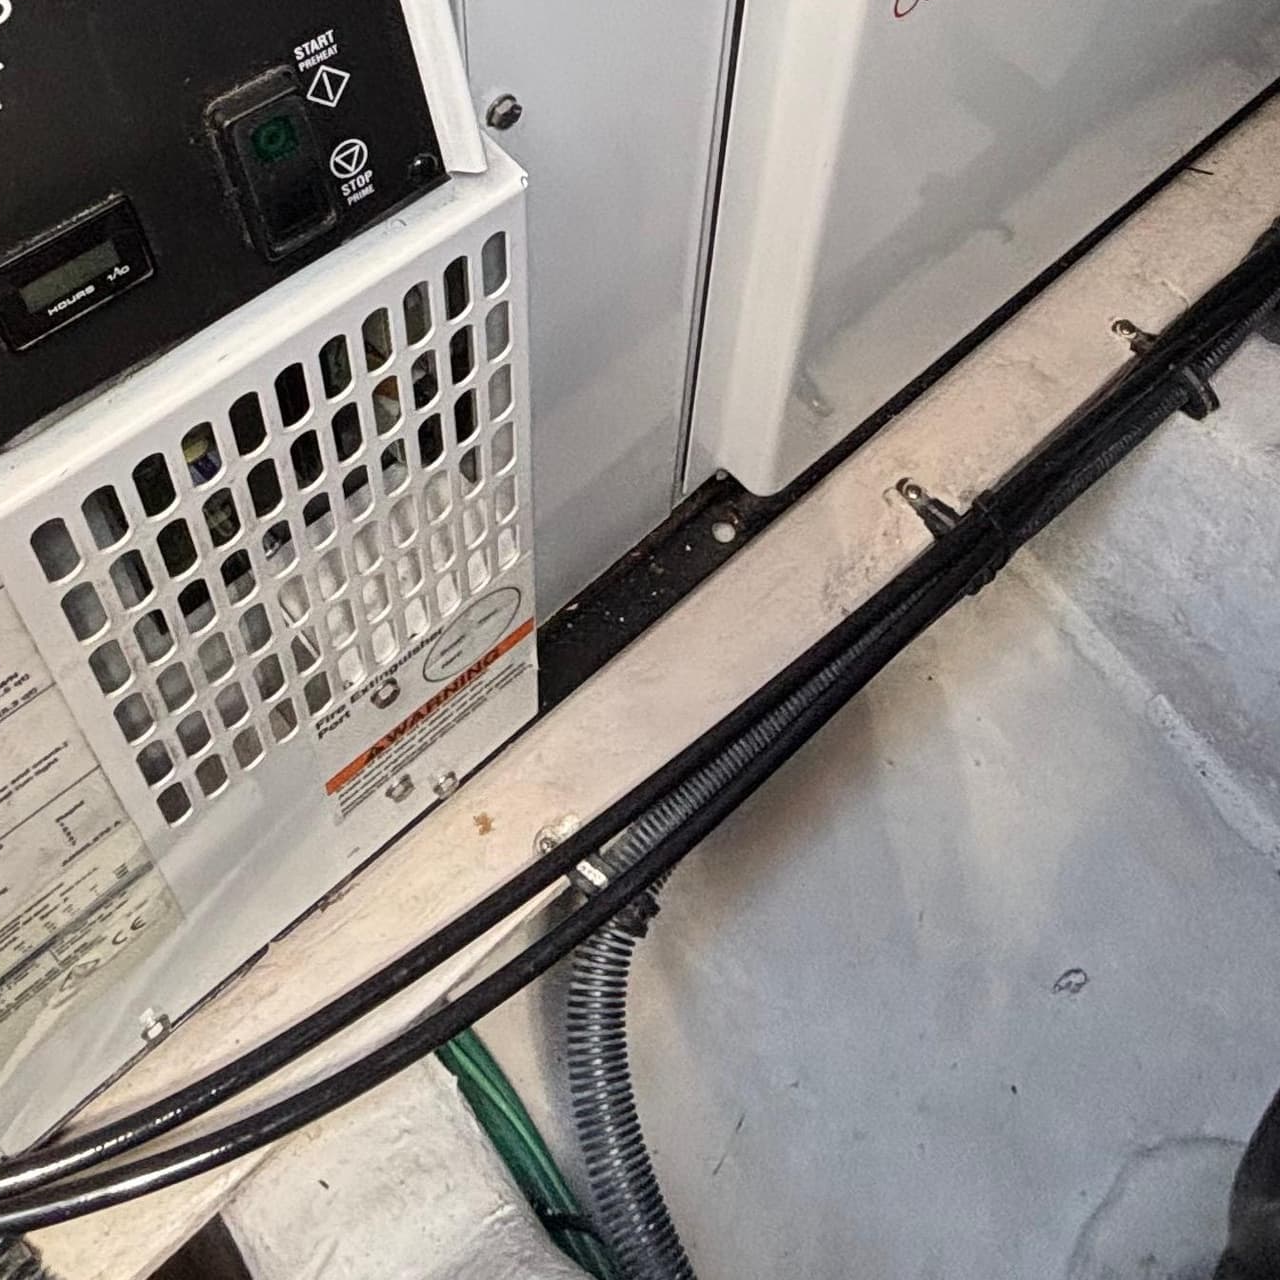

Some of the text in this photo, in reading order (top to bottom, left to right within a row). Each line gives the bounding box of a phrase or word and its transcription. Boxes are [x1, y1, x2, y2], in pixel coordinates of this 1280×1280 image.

[293, 29, 335, 61] START
[298, 44, 339, 72] PREHEAT
[340, 170, 373, 197] STOP
[347, 185, 375, 207] PRIME
[47, 284, 96, 317] HOURS
[315, 703, 347, 731] Fire
[317, 710, 351, 740] Port
